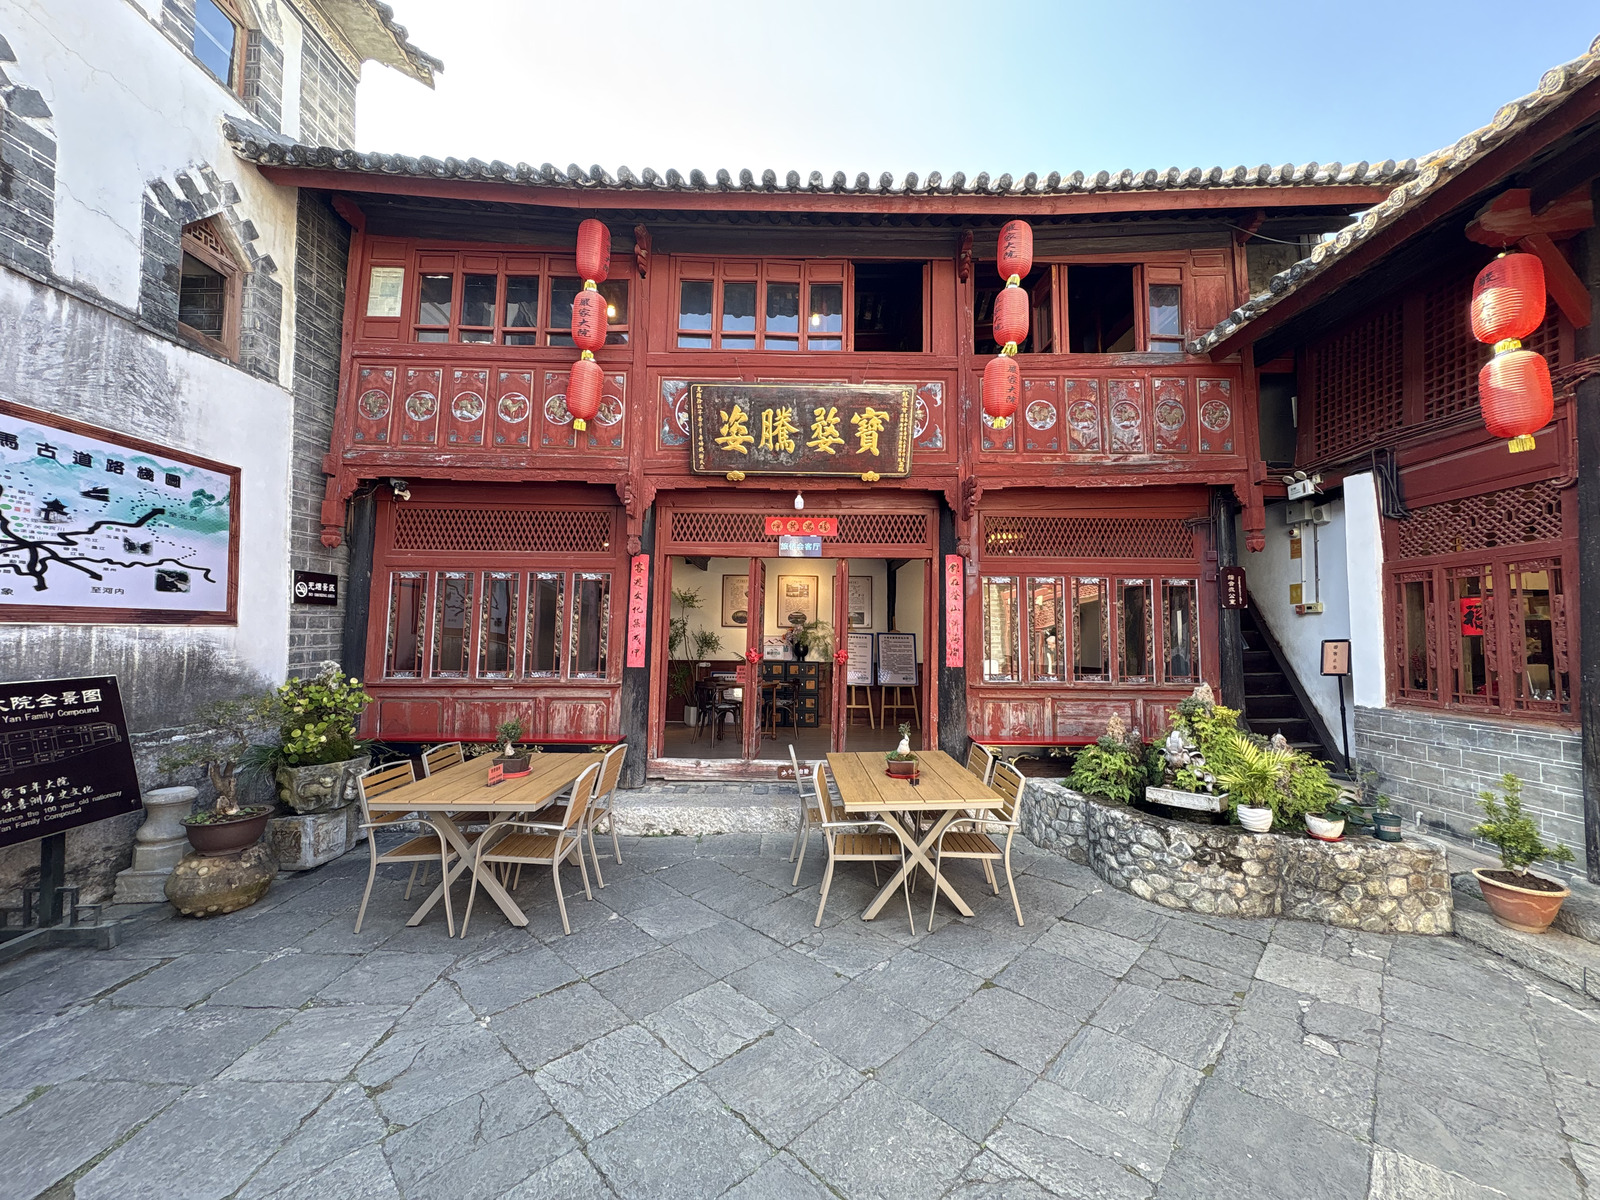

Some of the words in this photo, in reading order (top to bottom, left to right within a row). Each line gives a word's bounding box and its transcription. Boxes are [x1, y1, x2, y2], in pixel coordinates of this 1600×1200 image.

[90, 586, 125, 595] 至河内
[1, 714, 22, 724] Yan
[24, 711, 55, 722] Family
[57, 705, 100, 717] Compound
[1, 776, 70, 799] 家百年大院
[1, 785, 94, 813] 味喜洲历史文化
[43, 805, 57, 814] 100
[60, 802, 76, 811] year
[0, 825, 12, 833] an
[15, 818, 41, 829] Family
[43, 807, 82, 821] Compound
